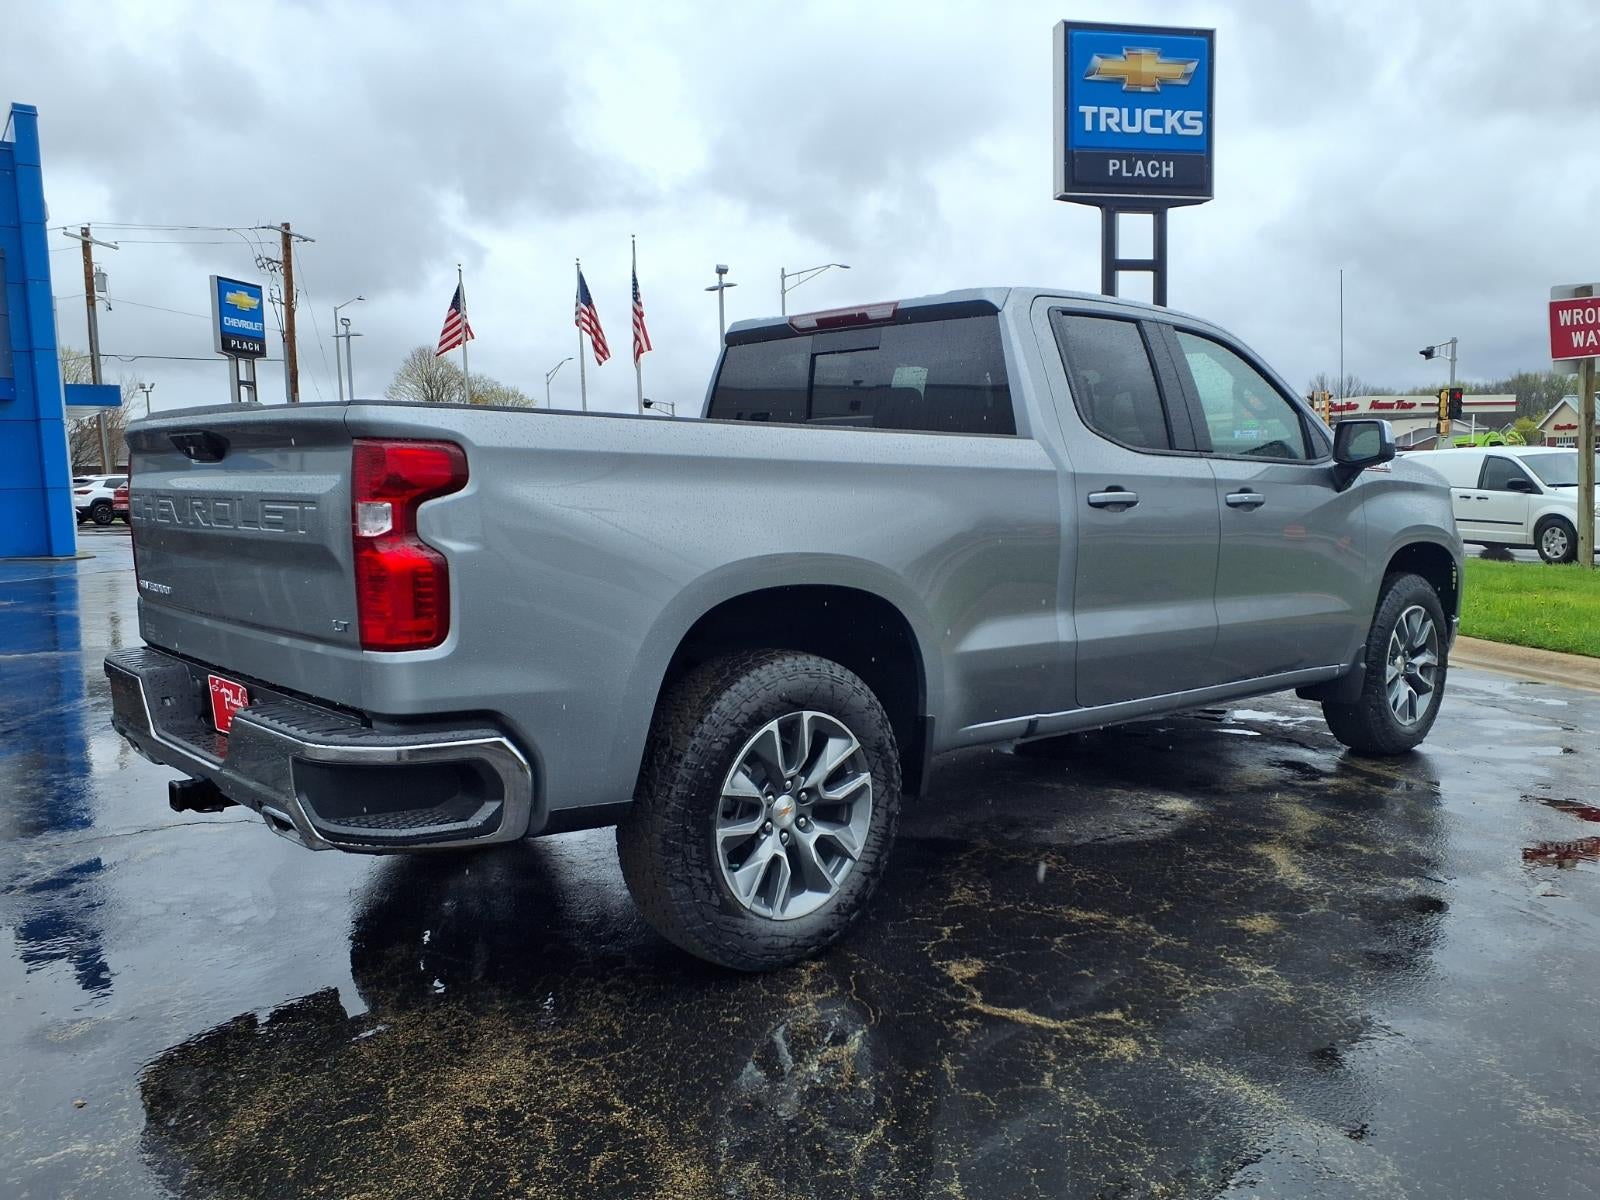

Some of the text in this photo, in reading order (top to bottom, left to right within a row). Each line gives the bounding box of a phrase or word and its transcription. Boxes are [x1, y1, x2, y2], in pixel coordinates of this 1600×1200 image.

[1078, 105, 1204, 136] TRUCKS
[1108, 159, 1174, 178] PLACH
[223, 316, 263, 332] CHEVROLET
[1558, 306, 1600, 326] WRO
[231, 339, 260, 352] PLACH
[1571, 329, 1600, 348] WA
